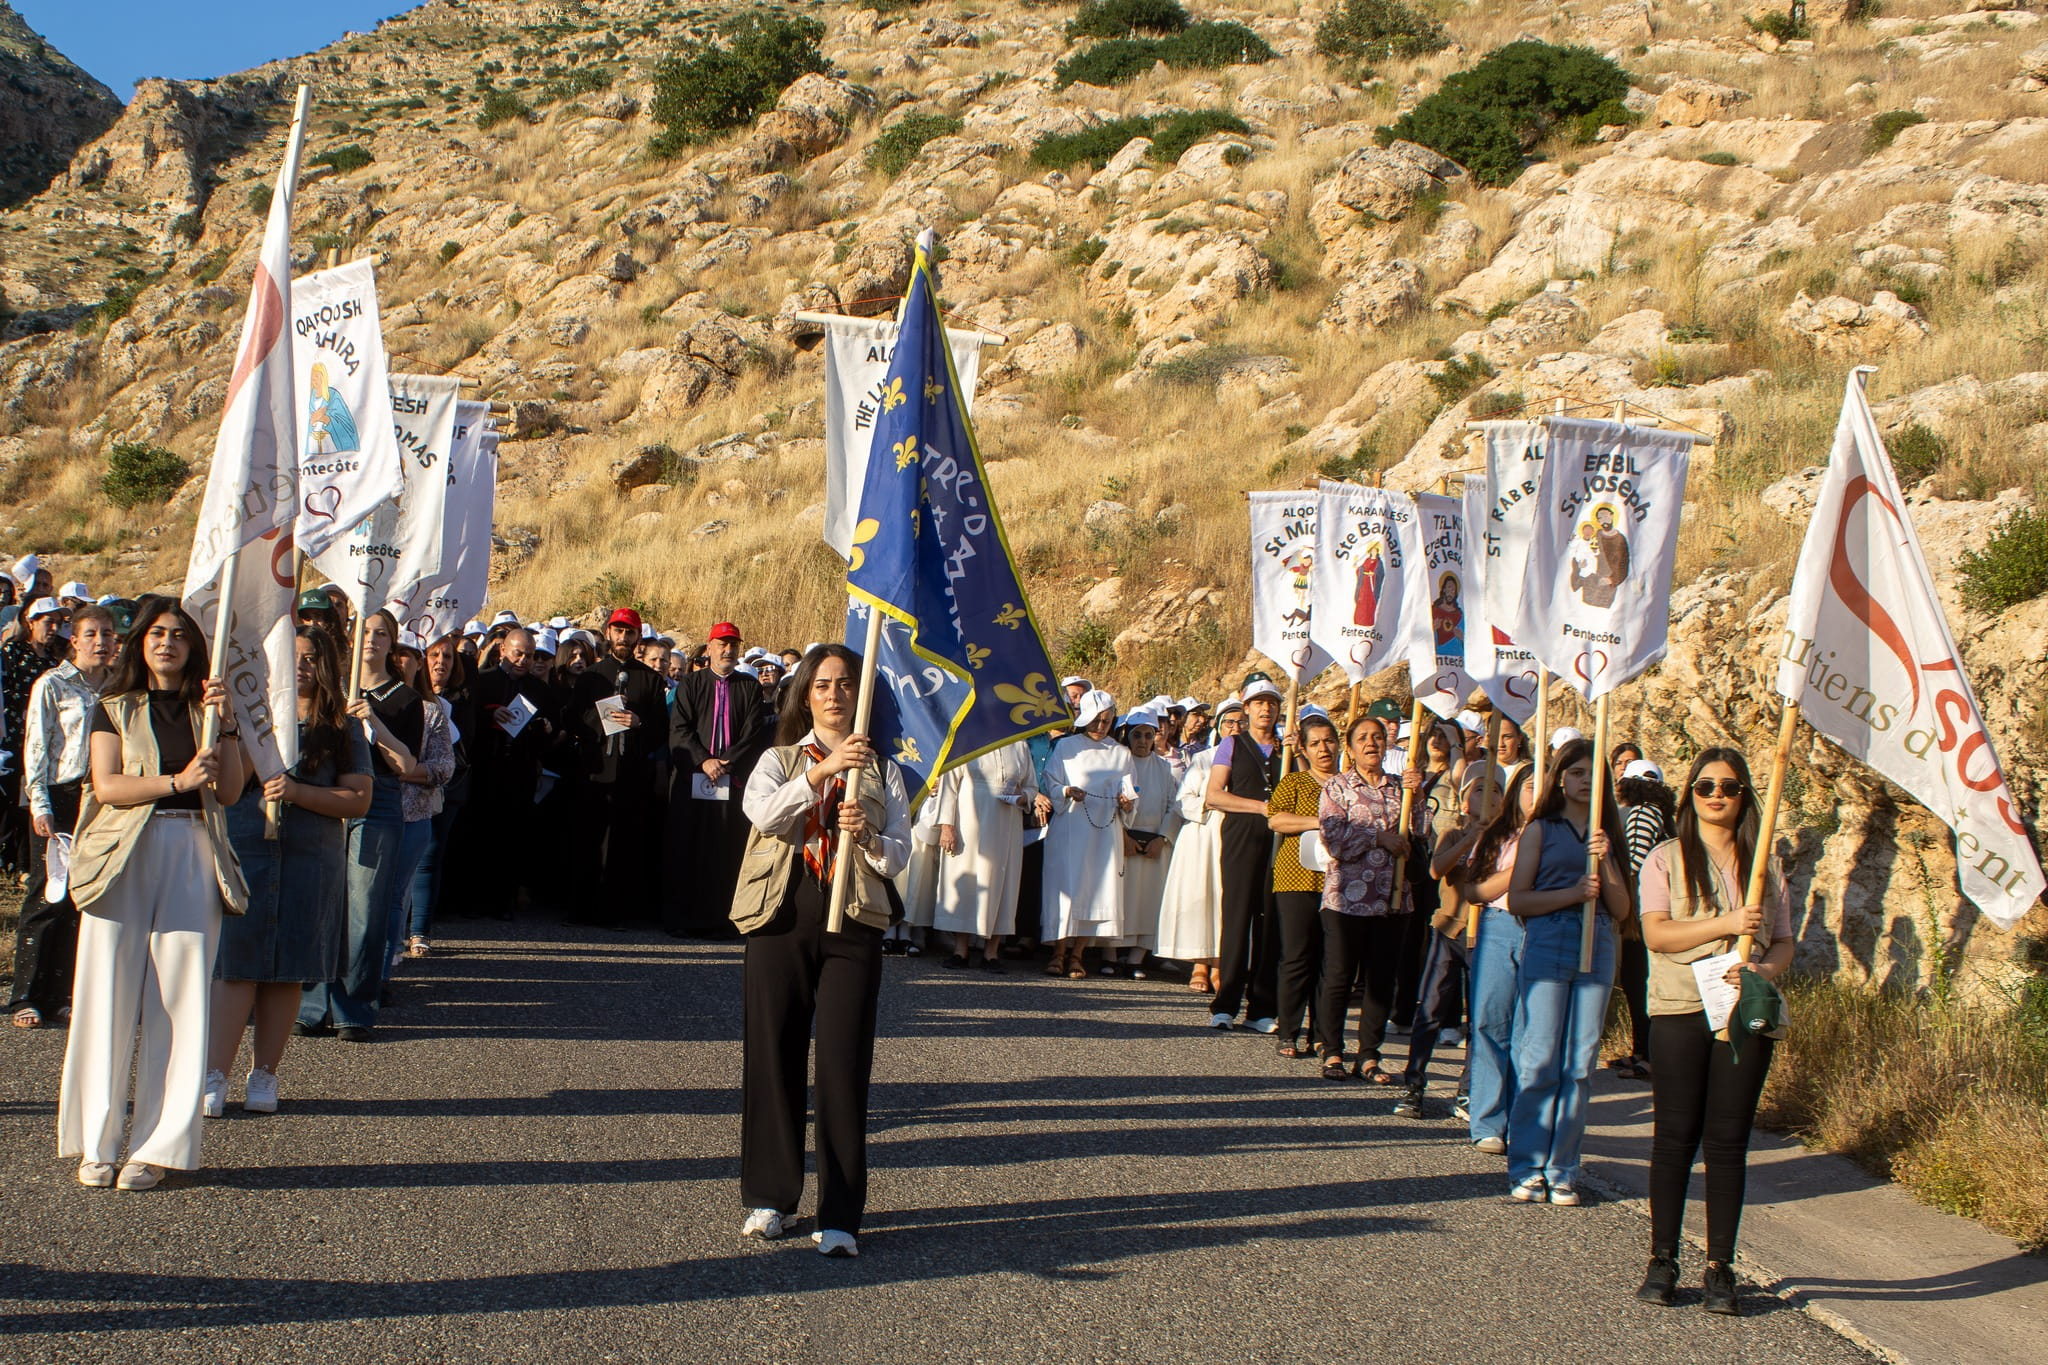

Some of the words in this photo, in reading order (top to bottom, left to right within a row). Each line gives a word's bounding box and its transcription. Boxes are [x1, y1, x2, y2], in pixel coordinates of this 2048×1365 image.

[389, 395, 429, 415] ESH
[855, 400, 876, 431] THE
[298, 459, 359, 476] ntecôte
[1584, 454, 1642, 476] ERBIL
[1491, 475, 1541, 522] RABB
[1560, 490, 1584, 519] St
[1583, 474, 1652, 524] Joseph
[1264, 535, 1287, 558] St
[1335, 532, 1358, 561] Ste
[1358, 521, 1402, 569] Barbara
[1341, 626, 1384, 642] Pentecôte
[1563, 623, 1622, 645] Pentecôte
